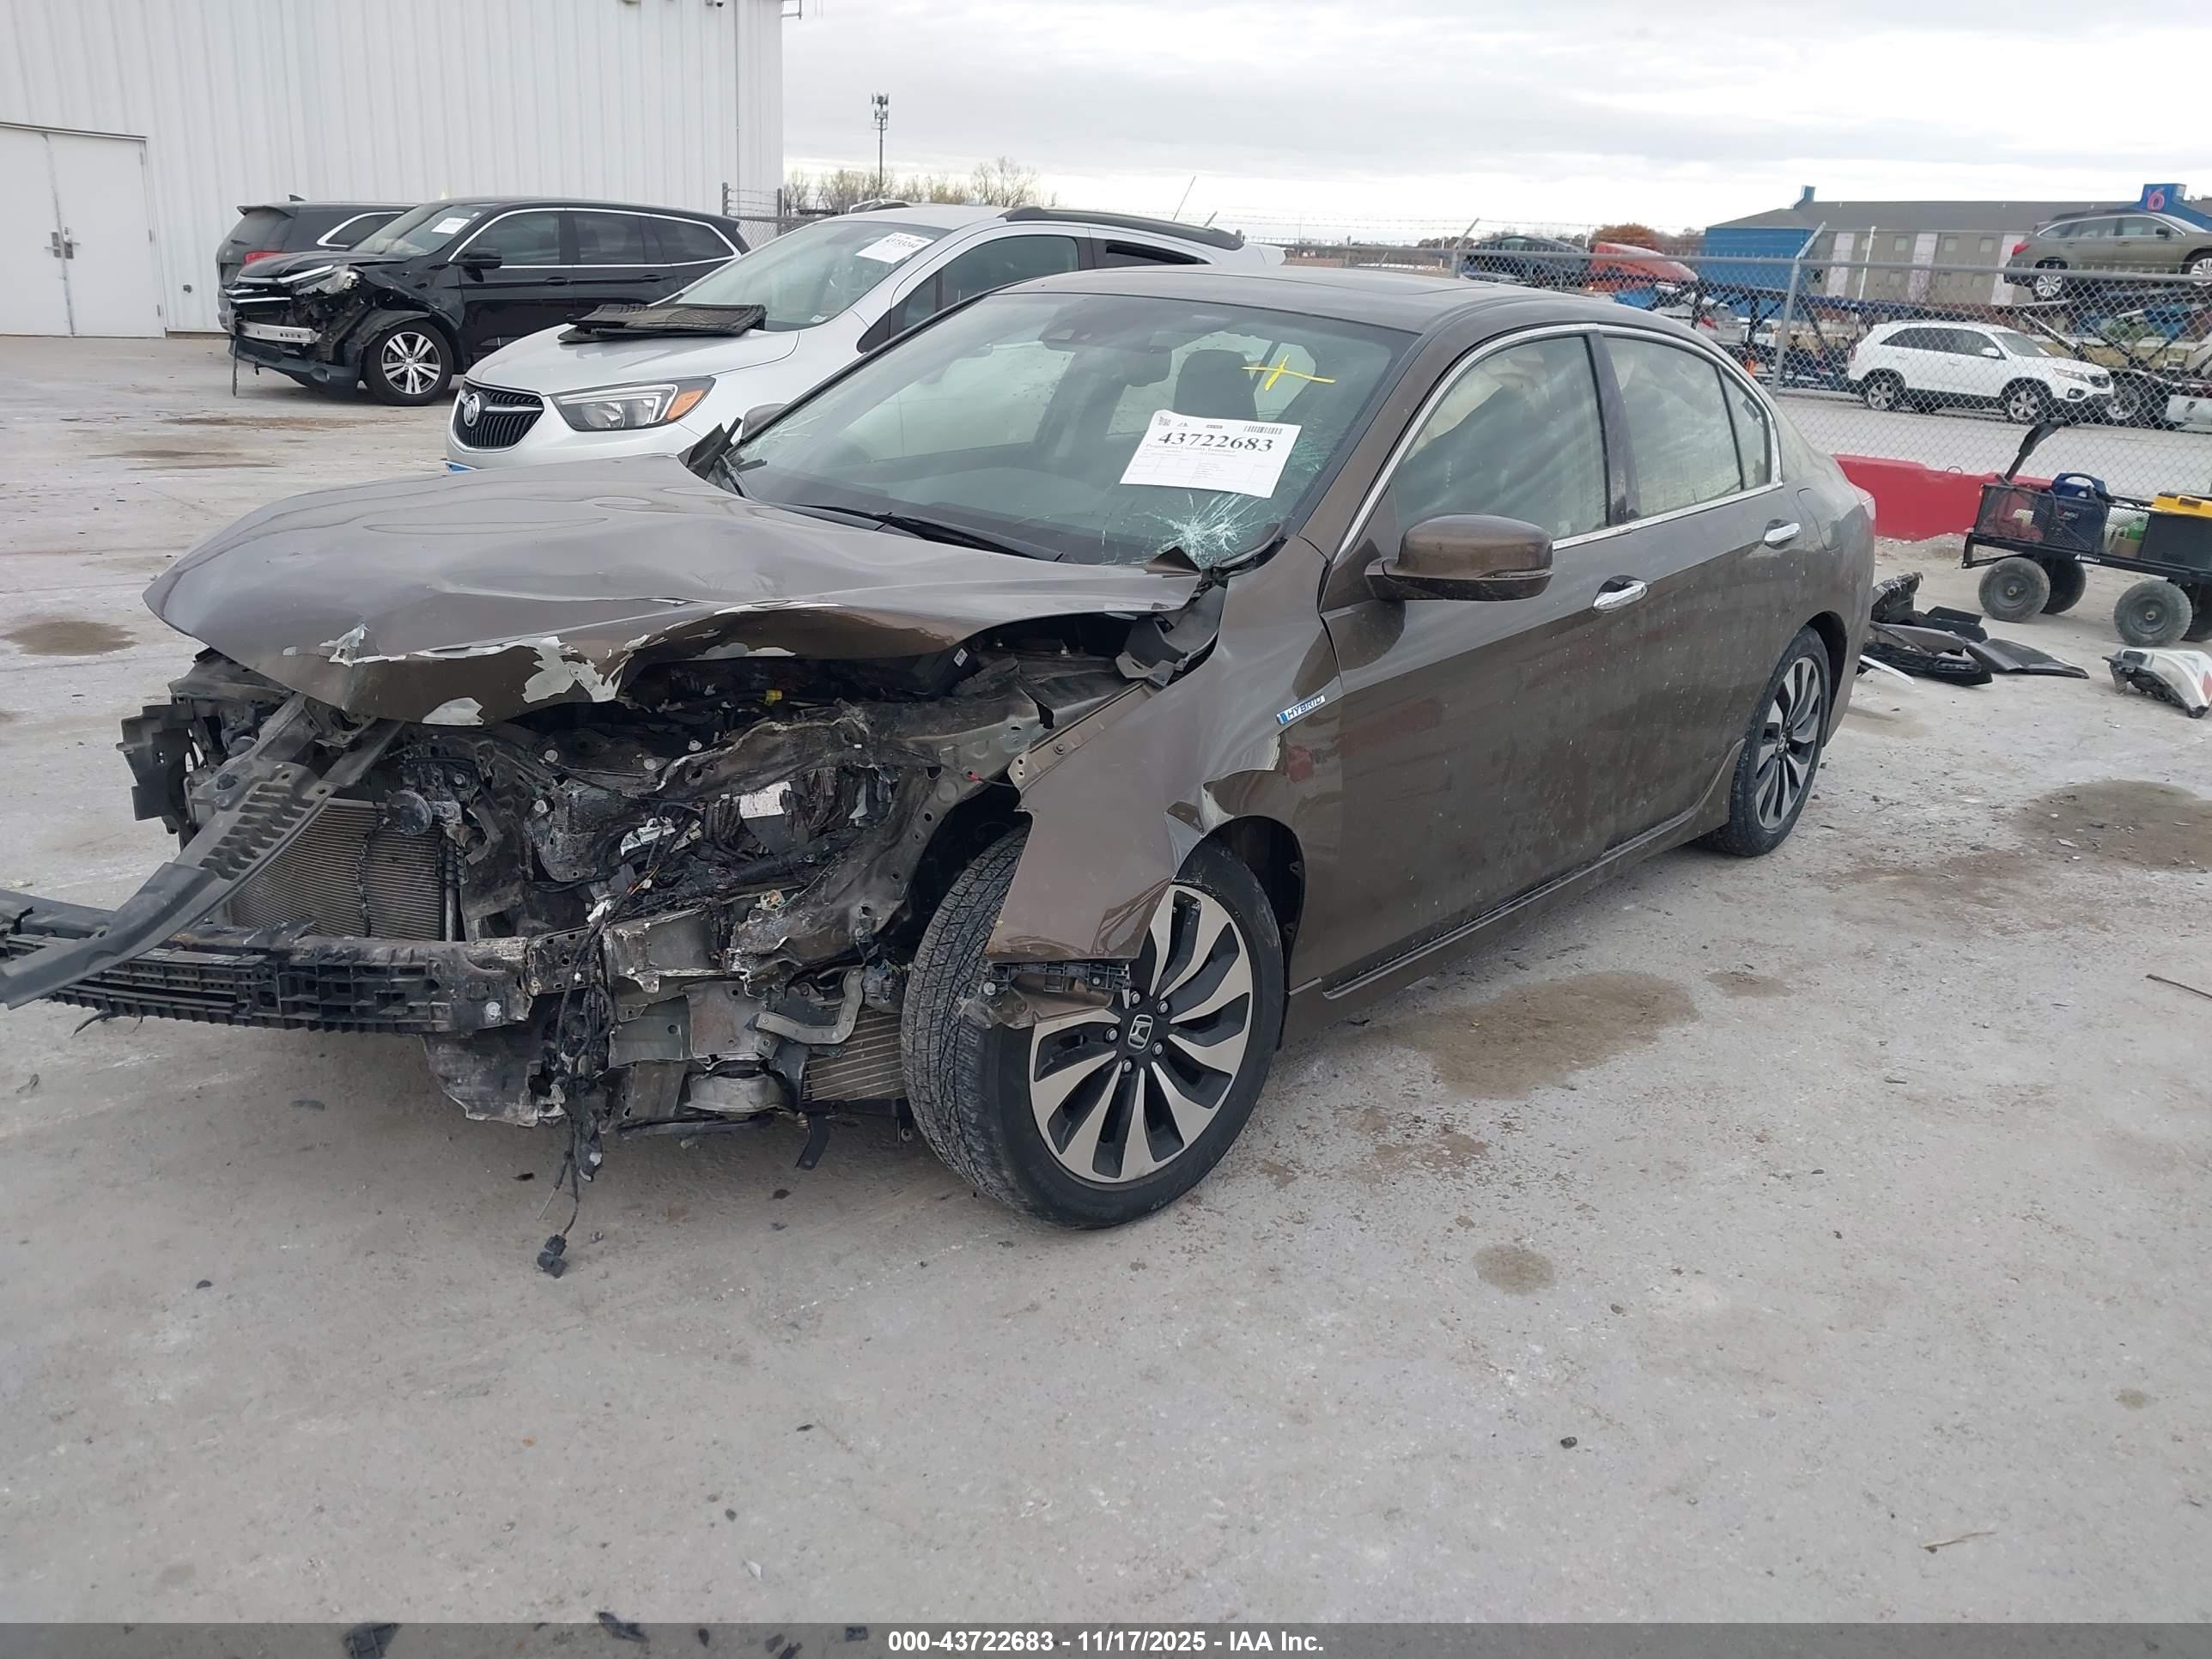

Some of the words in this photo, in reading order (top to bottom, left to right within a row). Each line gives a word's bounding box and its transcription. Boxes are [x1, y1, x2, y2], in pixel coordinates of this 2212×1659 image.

[2147, 186, 2165, 211] 6
[1158, 432, 1273, 453] 43722683
[1287, 696, 1322, 718] HYBRID
